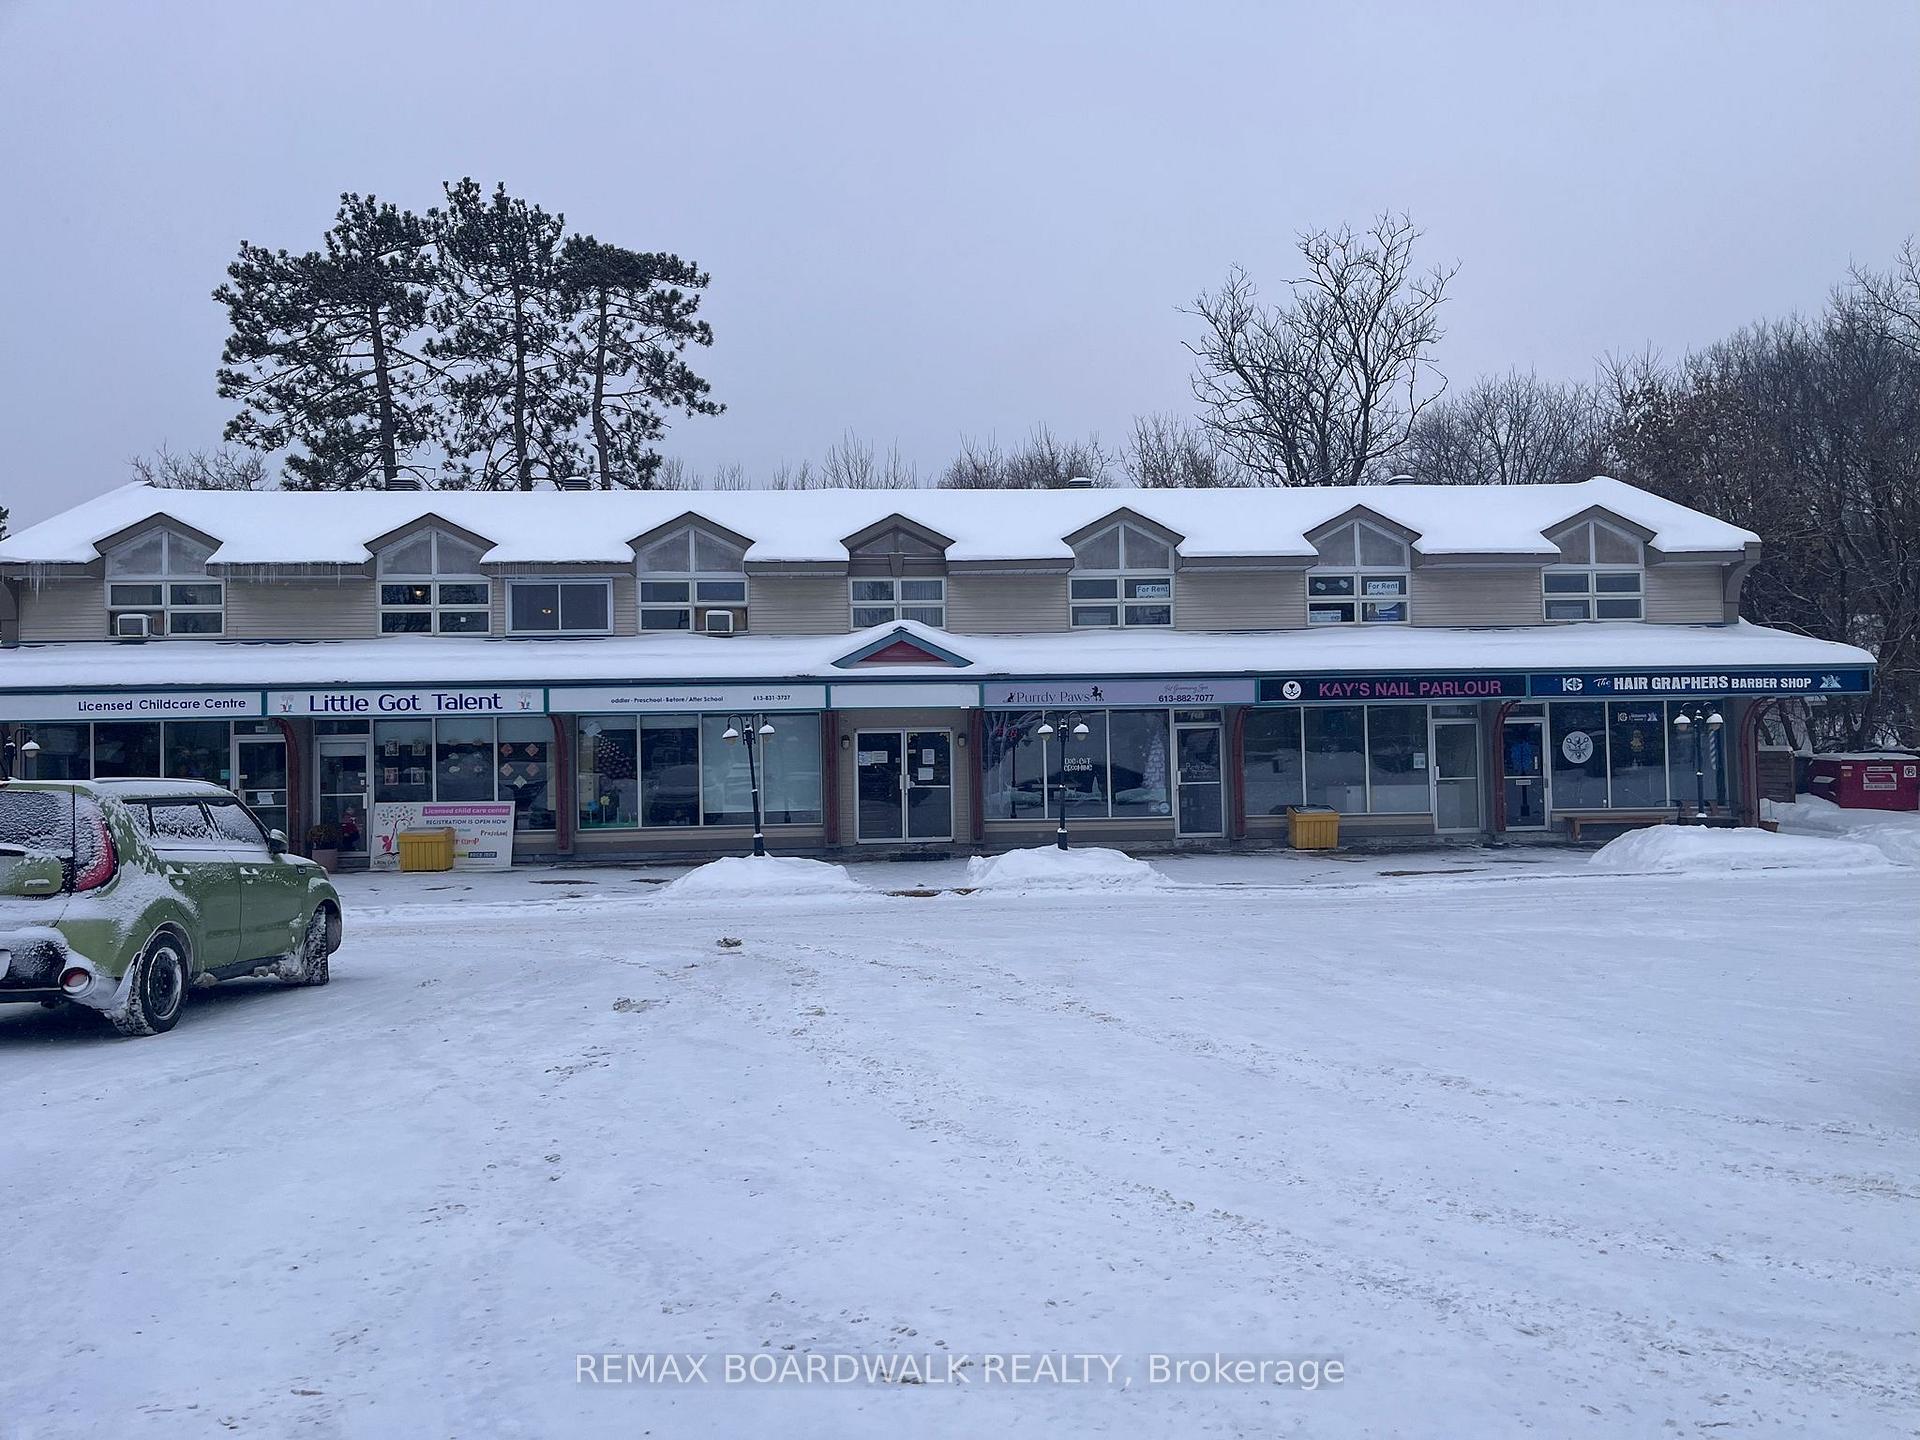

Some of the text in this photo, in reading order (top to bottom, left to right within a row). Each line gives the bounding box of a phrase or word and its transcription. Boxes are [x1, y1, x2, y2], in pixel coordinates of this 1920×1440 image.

[1151, 585, 1169, 593] Rent
[1319, 680, 1502, 697] KAY'S NAIL PARLOUR
[1593, 675, 1812, 690] The HAIR GRAPHERS BARBER SHOP
[309, 693, 503, 712] Little Got Talent
[1060, 691, 1091, 702] Paws
[1158, 694, 1214, 702] 613-882-7077
[78, 698, 246, 711] Licensed Childcare Centre
[425, 807, 454, 815] Licensed
[455, 807, 471, 815] child
